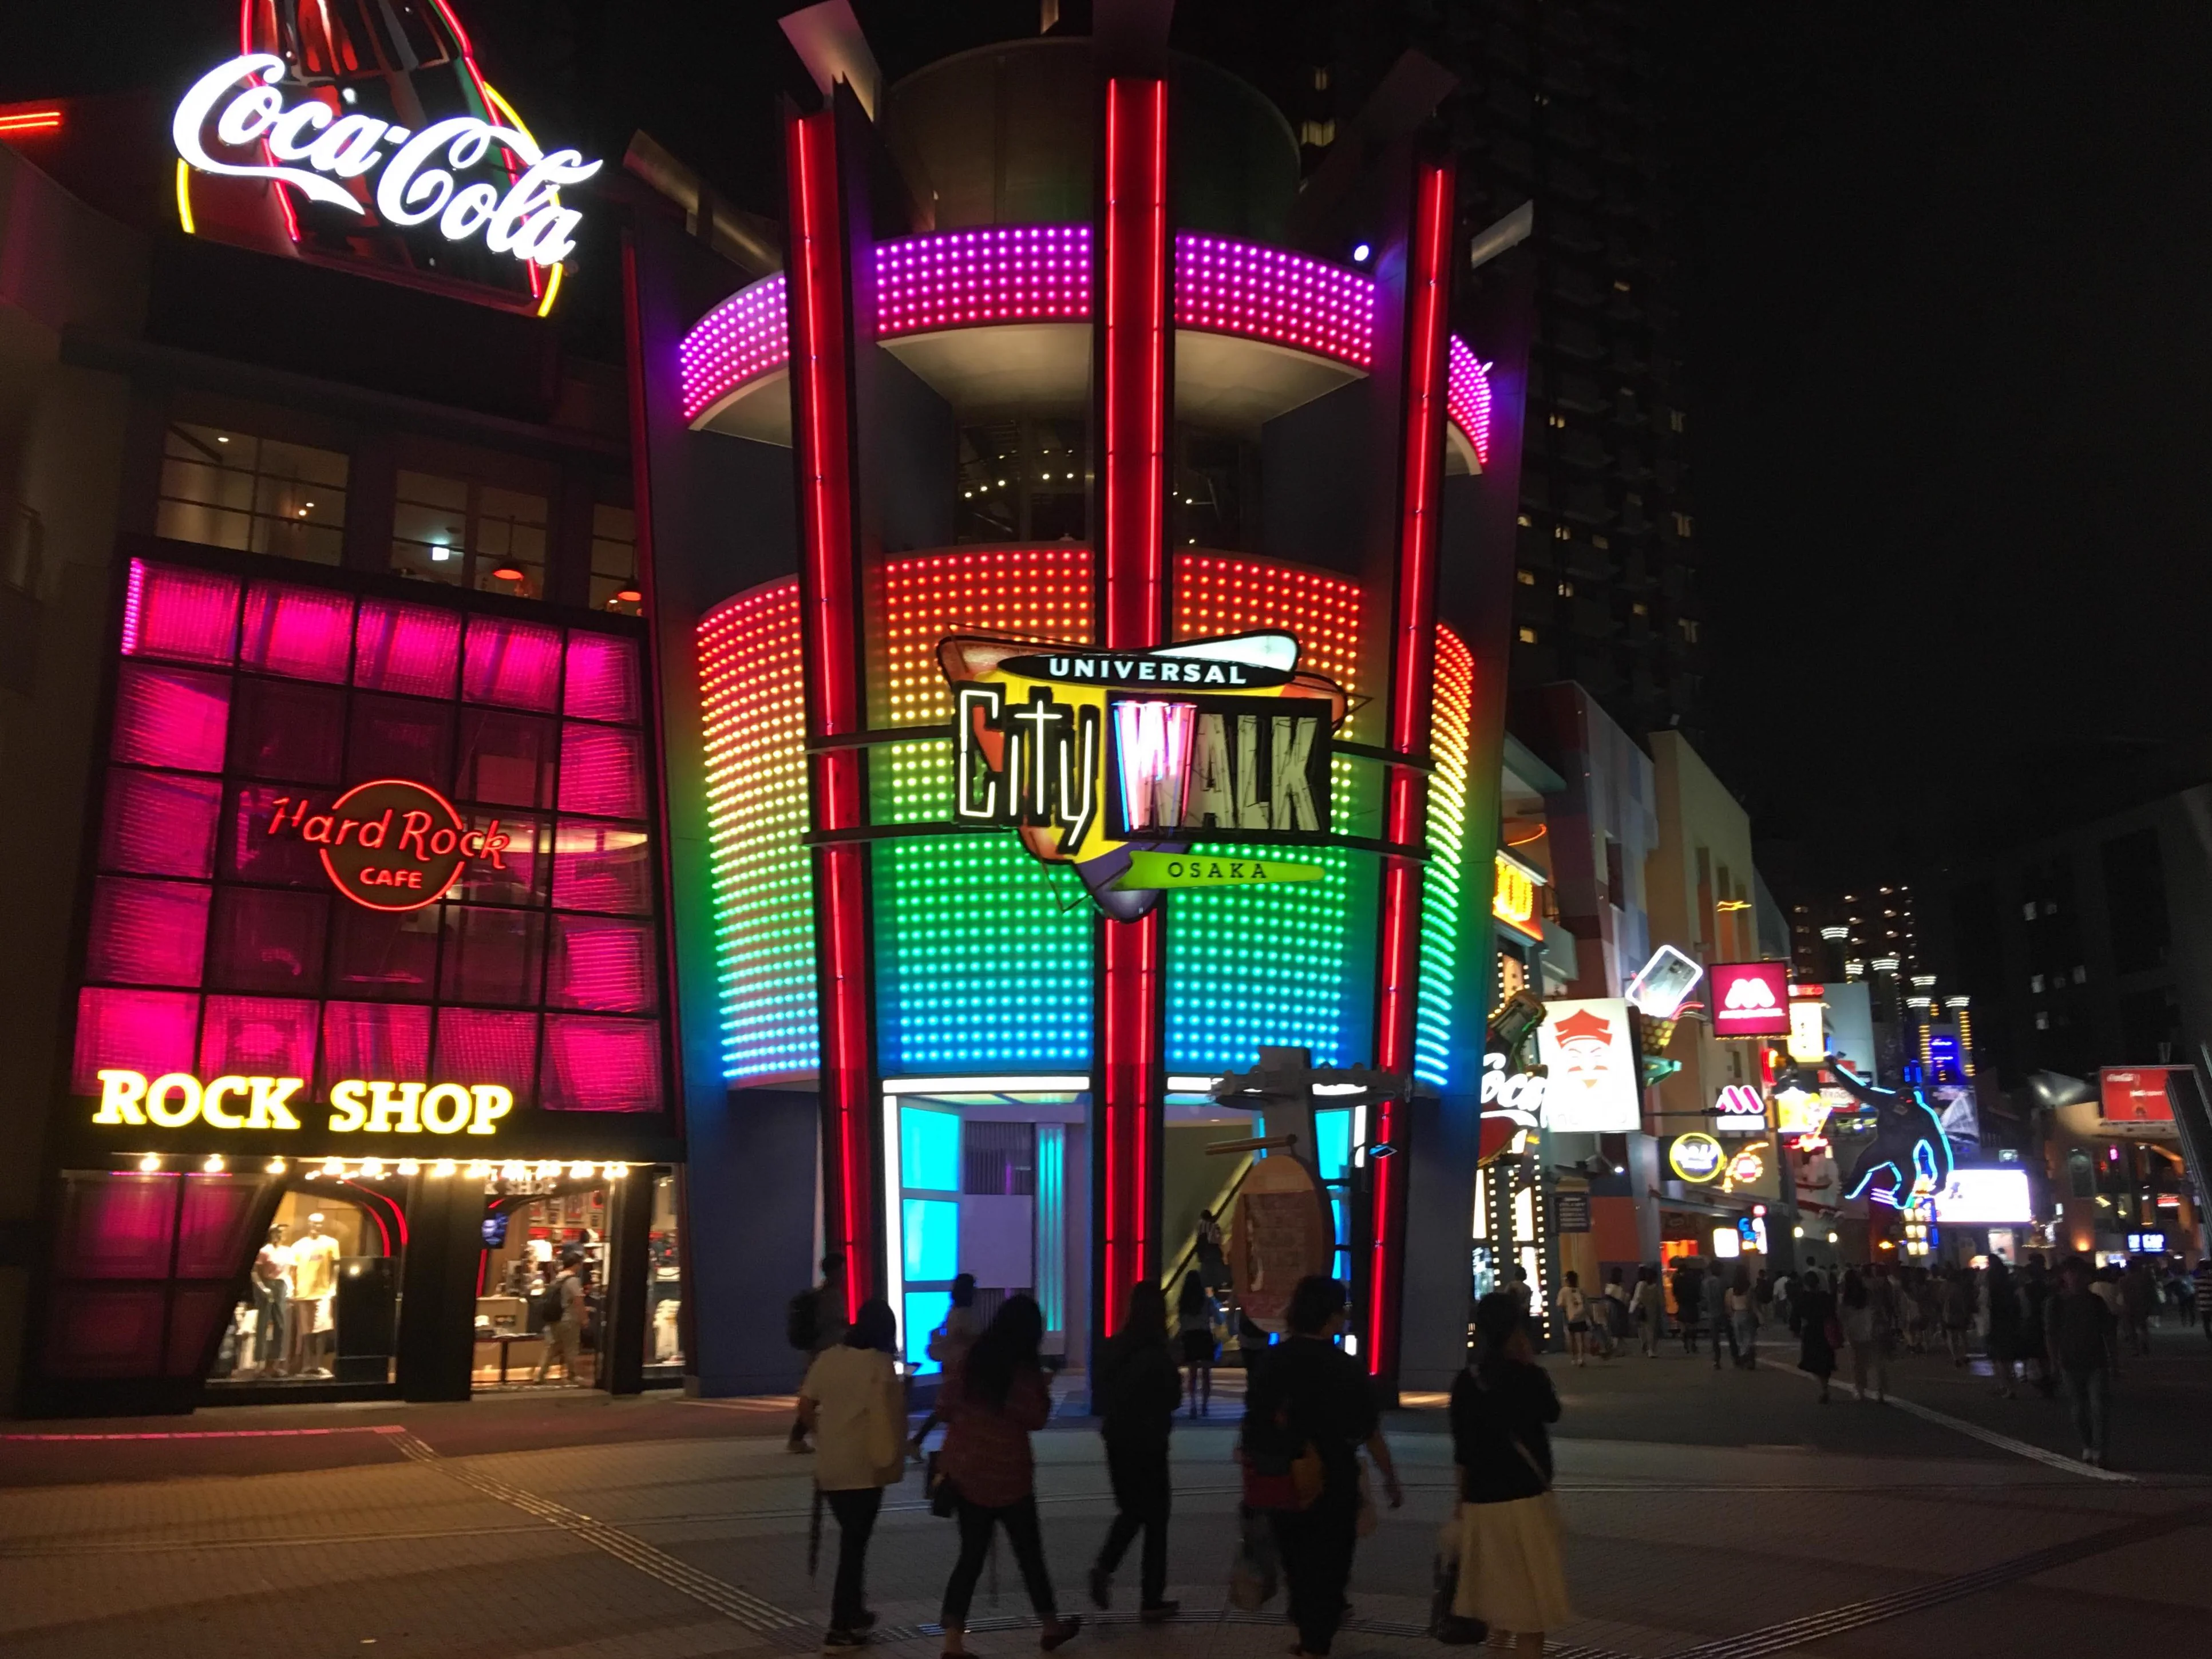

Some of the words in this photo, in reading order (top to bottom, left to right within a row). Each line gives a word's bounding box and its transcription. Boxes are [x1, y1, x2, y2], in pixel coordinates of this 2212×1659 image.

[173, 53, 603, 266] Coca-Cola
[1049, 658, 1247, 686] UNIVERSAL
[960, 690, 1092, 847] City
[1111, 700, 1321, 833] WALK
[268, 797, 394, 848] Hard
[398, 810, 510, 869] Rock
[359, 867, 422, 889] CAFE
[1168, 861, 1267, 880] OSAKA
[92, 1069, 304, 1130] ROCK
[328, 1079, 513, 1134] SHOP
